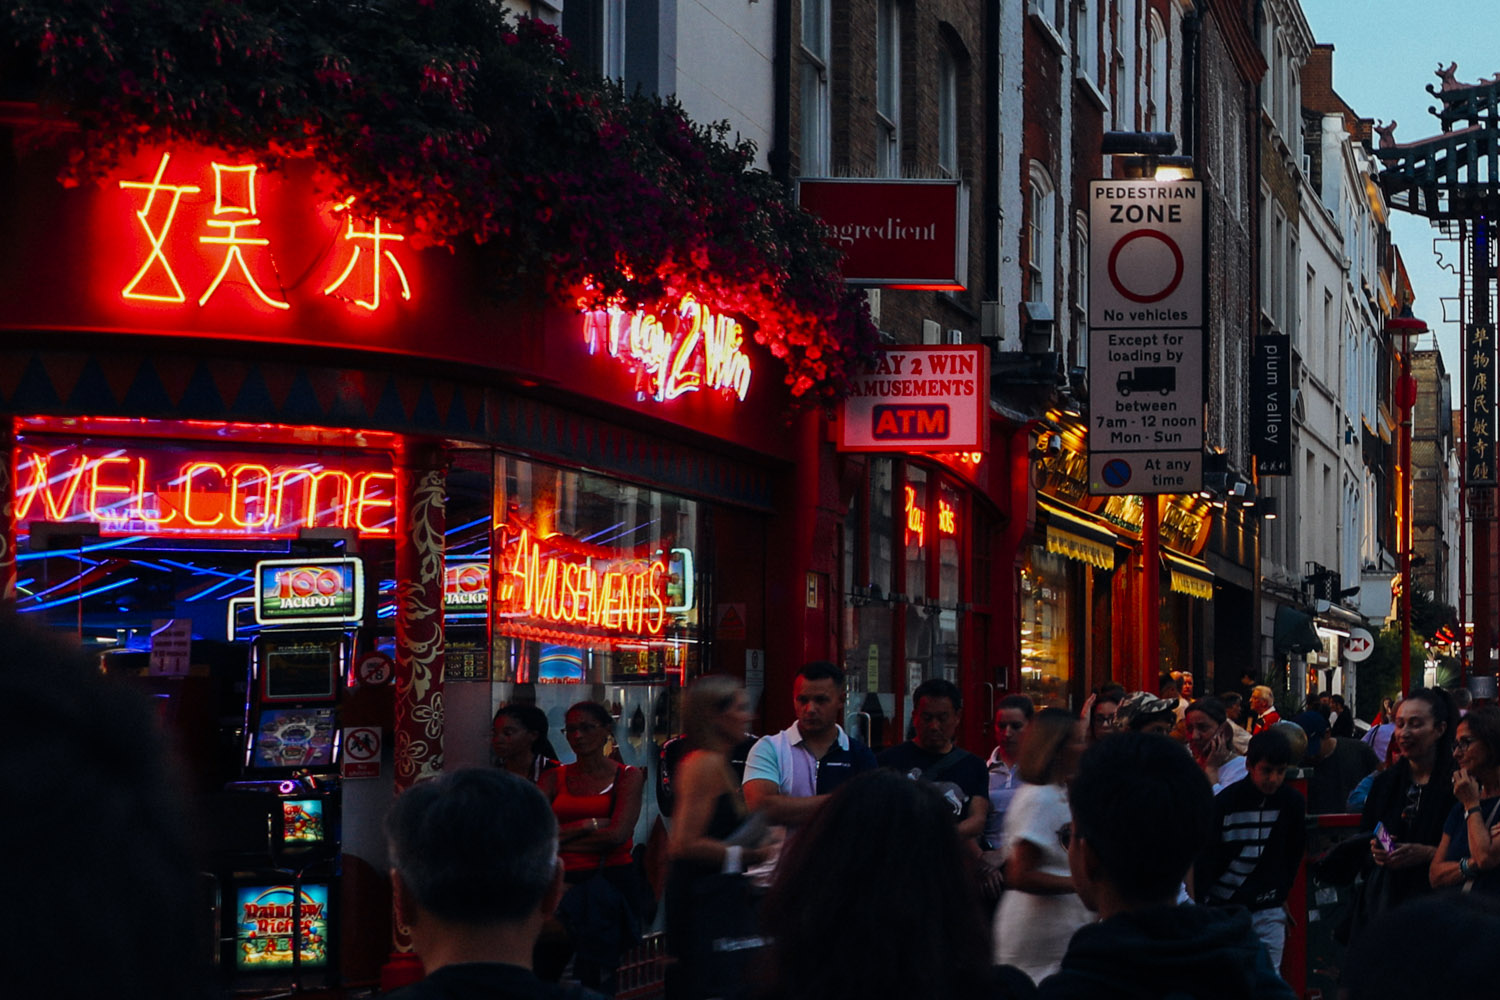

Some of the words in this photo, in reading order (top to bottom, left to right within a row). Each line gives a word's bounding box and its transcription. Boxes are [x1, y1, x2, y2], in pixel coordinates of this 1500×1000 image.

[1096, 187, 1196, 199] PEDESTRIAN
[1110, 204, 1182, 223] ZONE
[1104, 309, 1124, 321] No
[1129, 308, 1188, 321] vehicles
[663, 291, 700, 399] 2
[1108, 334, 1158, 347] Except
[1163, 333, 1184, 345] for
[1108, 350, 1161, 362] loading
[1166, 349, 1184, 362] by
[910, 356, 924, 376] 2
[928, 354, 975, 375] WIN
[1264, 344, 1281, 385] plum
[850, 379, 975, 397] AMUSEMENTS
[1115, 400, 1177, 412] between
[875, 409, 946, 435] ATM
[1096, 416, 1127, 428] 7am
[1141, 415, 1156, 427] 12
[1162, 416, 1197, 427] noon
[1264, 391, 1282, 444] valley
[1111, 431, 1141, 443] Mon
[1154, 431, 1182, 442] Sun
[1144, 459, 1161, 470] At
[1166, 460, 1191, 471] any
[1152, 474, 1184, 486] time
[14, 453, 394, 533] WELCOME
[511, 529, 665, 634] AMUSEMENTS
[280, 595, 337, 609] JACKPOT
